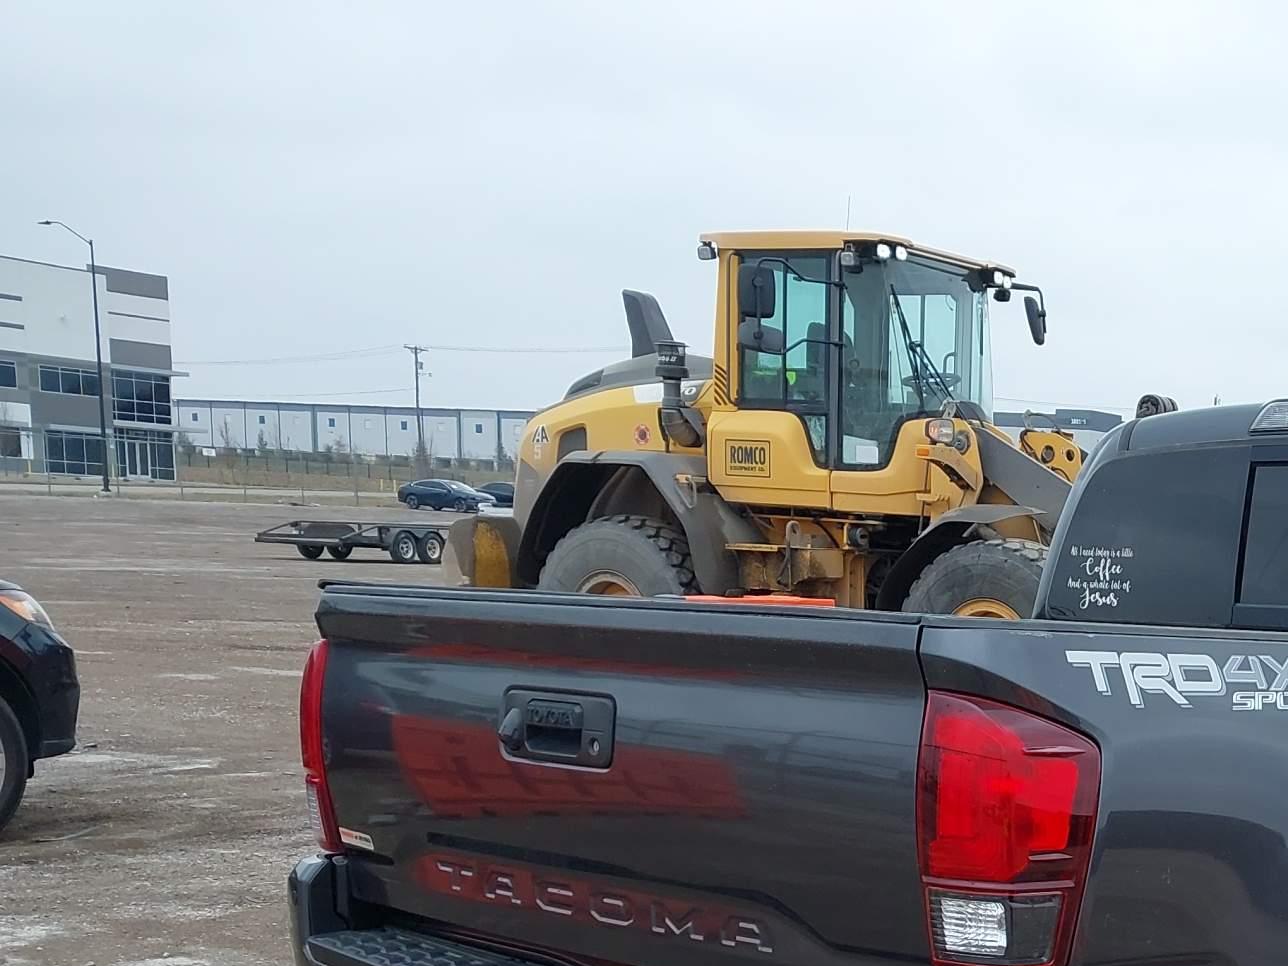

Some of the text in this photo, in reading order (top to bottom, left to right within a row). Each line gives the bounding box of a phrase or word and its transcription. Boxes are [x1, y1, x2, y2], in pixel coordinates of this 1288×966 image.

[730, 445, 766, 466] ROMCO
[1080, 557, 1123, 581] Coffee
[1067, 576, 1081, 589] And
[1089, 579, 1109, 589] whole
[1110, 580, 1121, 590] lot
[1122, 580, 1132, 593] of
[1080, 587, 1120, 610] Jesus
[1065, 650, 1227, 708] TRD
[527, 706, 576, 727] TOYOTA
[436, 859, 775, 953] TACOMA
